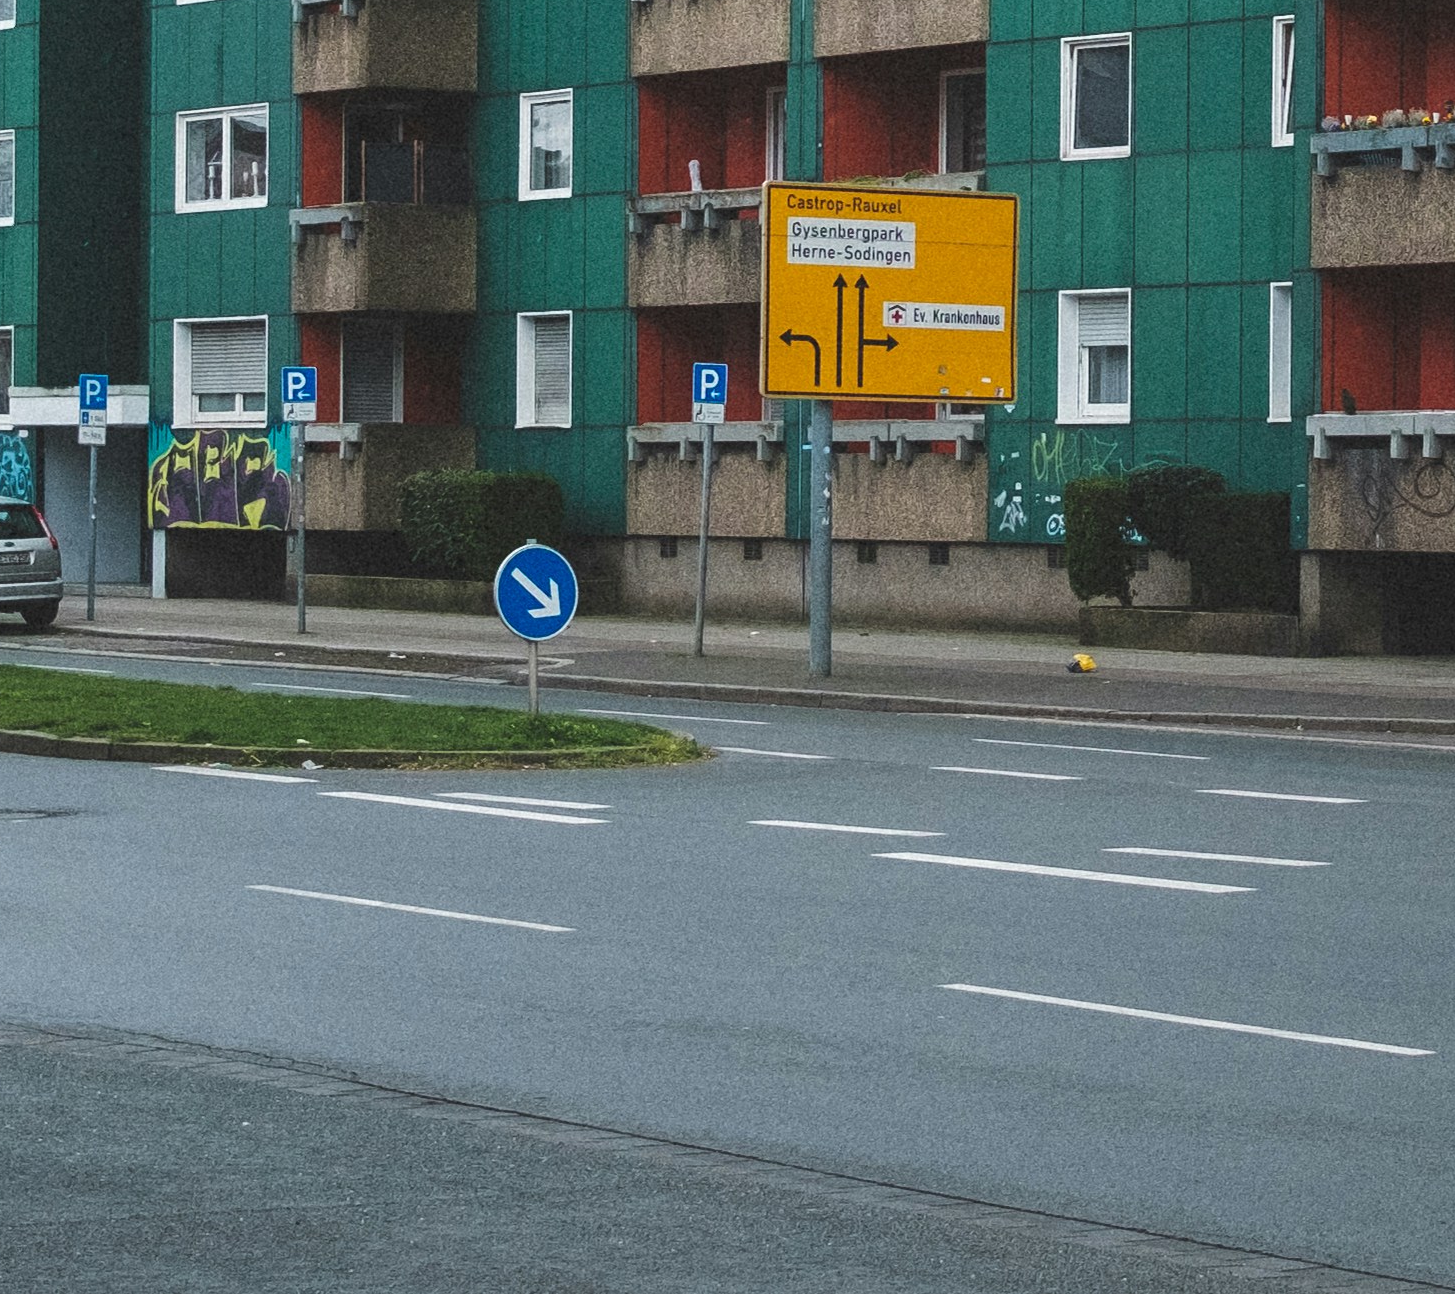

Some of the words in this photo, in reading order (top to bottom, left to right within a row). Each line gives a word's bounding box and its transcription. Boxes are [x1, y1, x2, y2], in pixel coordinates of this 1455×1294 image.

[787, 194, 902, 215] Castrop-Rauxel
[792, 222, 903, 243] Gysenbergpark
[791, 243, 911, 265] Herne-Sodingen
[913, 308, 927, 323] Ev.
[933, 309, 1000, 326] Krankenhaus
[86, 380, 101, 405] P
[288, 372, 306, 399] P
[701, 369, 719, 399] P
